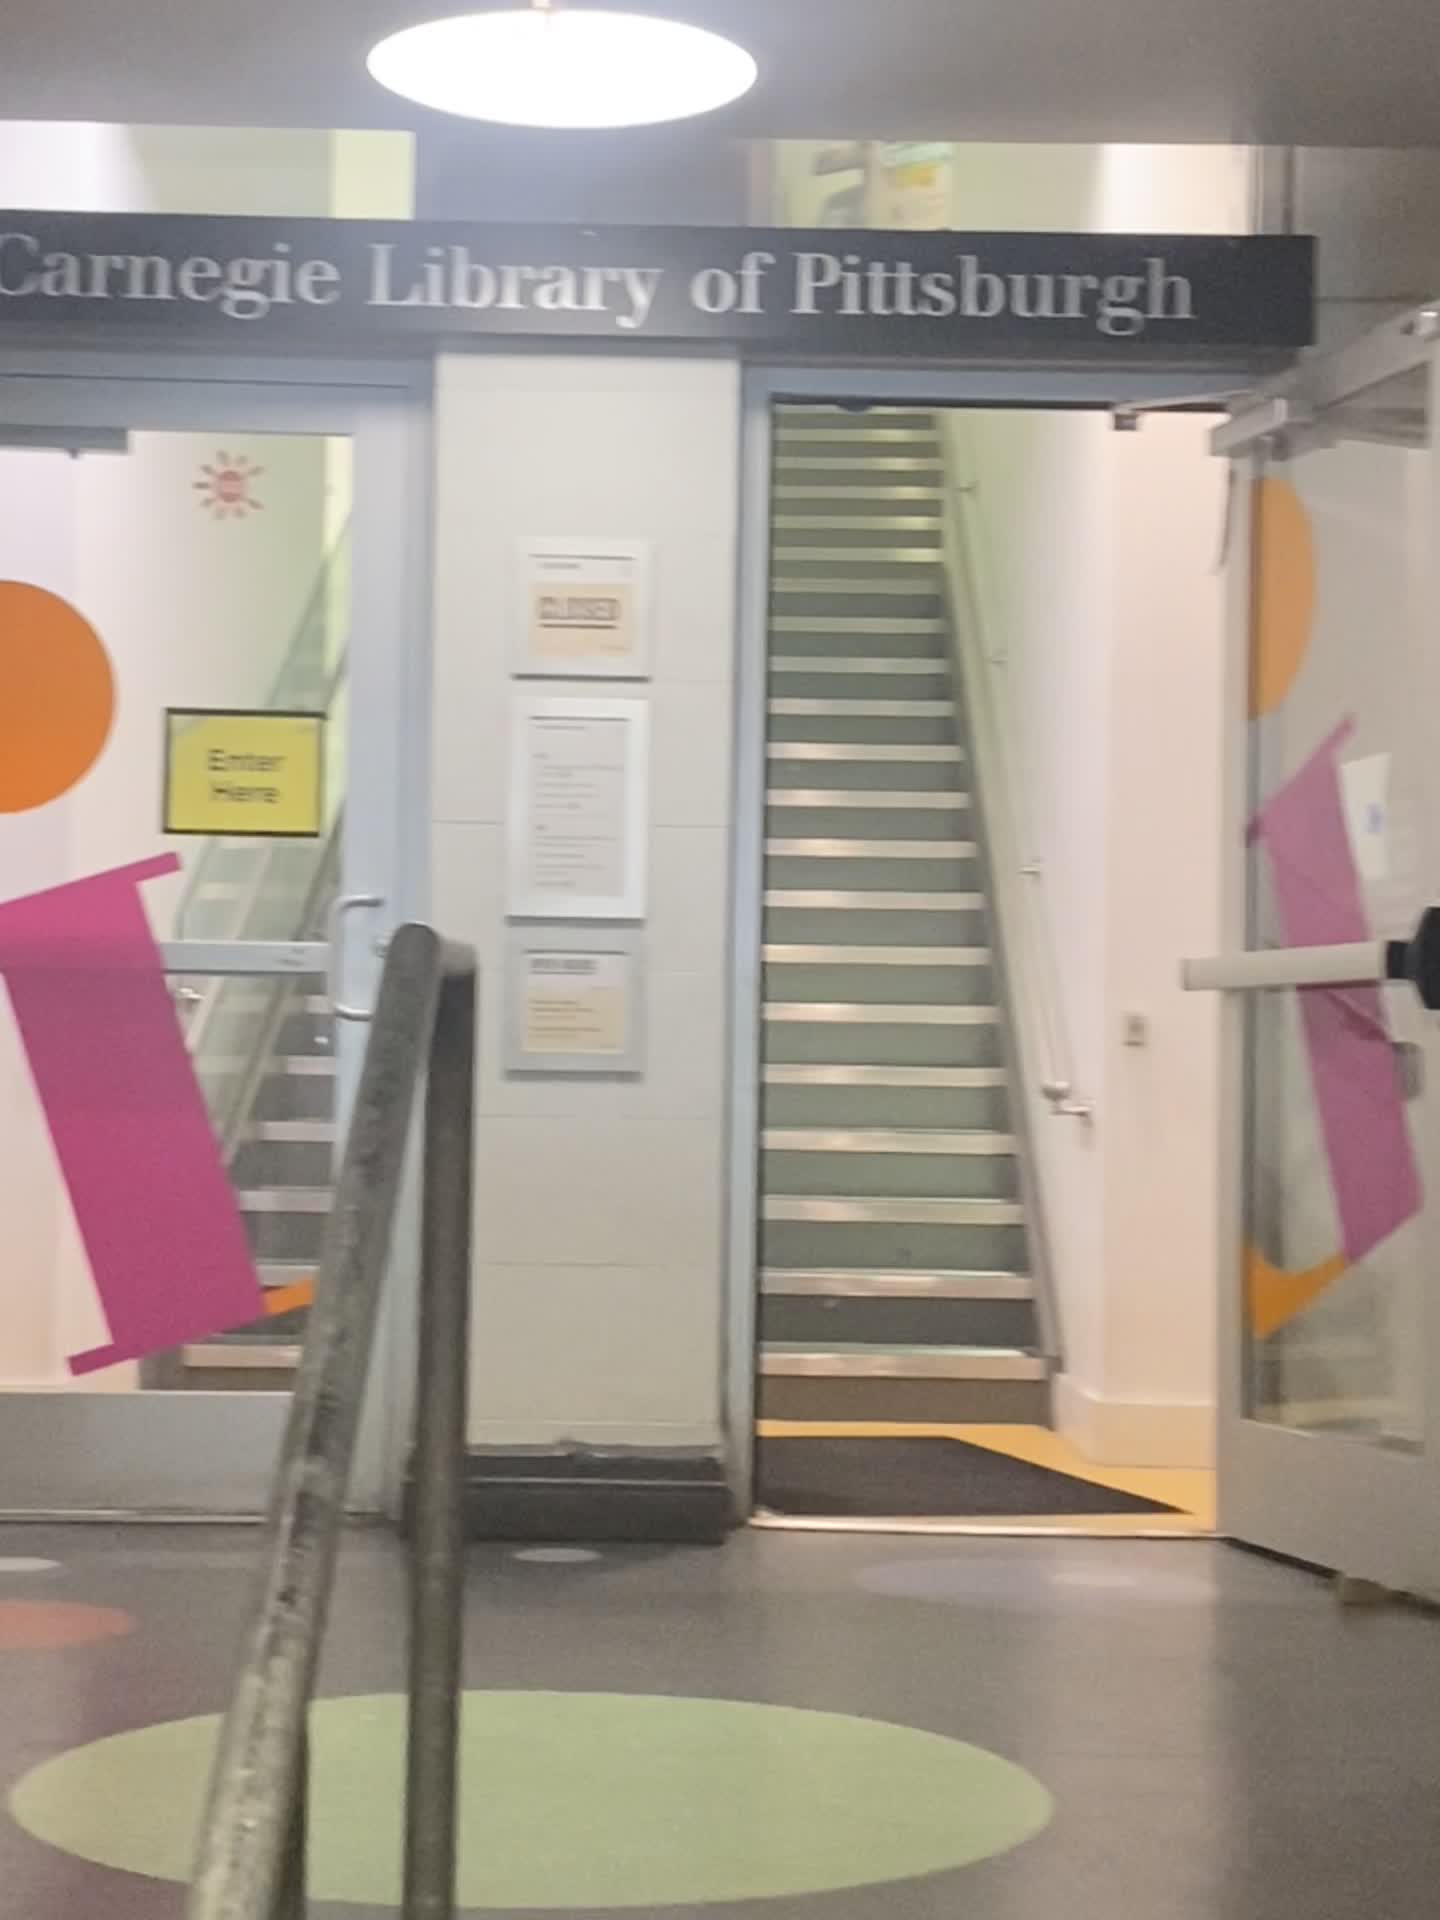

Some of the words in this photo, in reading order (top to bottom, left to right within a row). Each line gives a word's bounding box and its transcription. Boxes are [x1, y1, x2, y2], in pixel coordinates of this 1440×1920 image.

[0, 232, 341, 320] Carnegie
[365, 243, 664, 329] Library
[690, 252, 776, 314] of
[790, 250, 1196, 336] Pittsburgh
[208, 747, 286, 772] Enter
